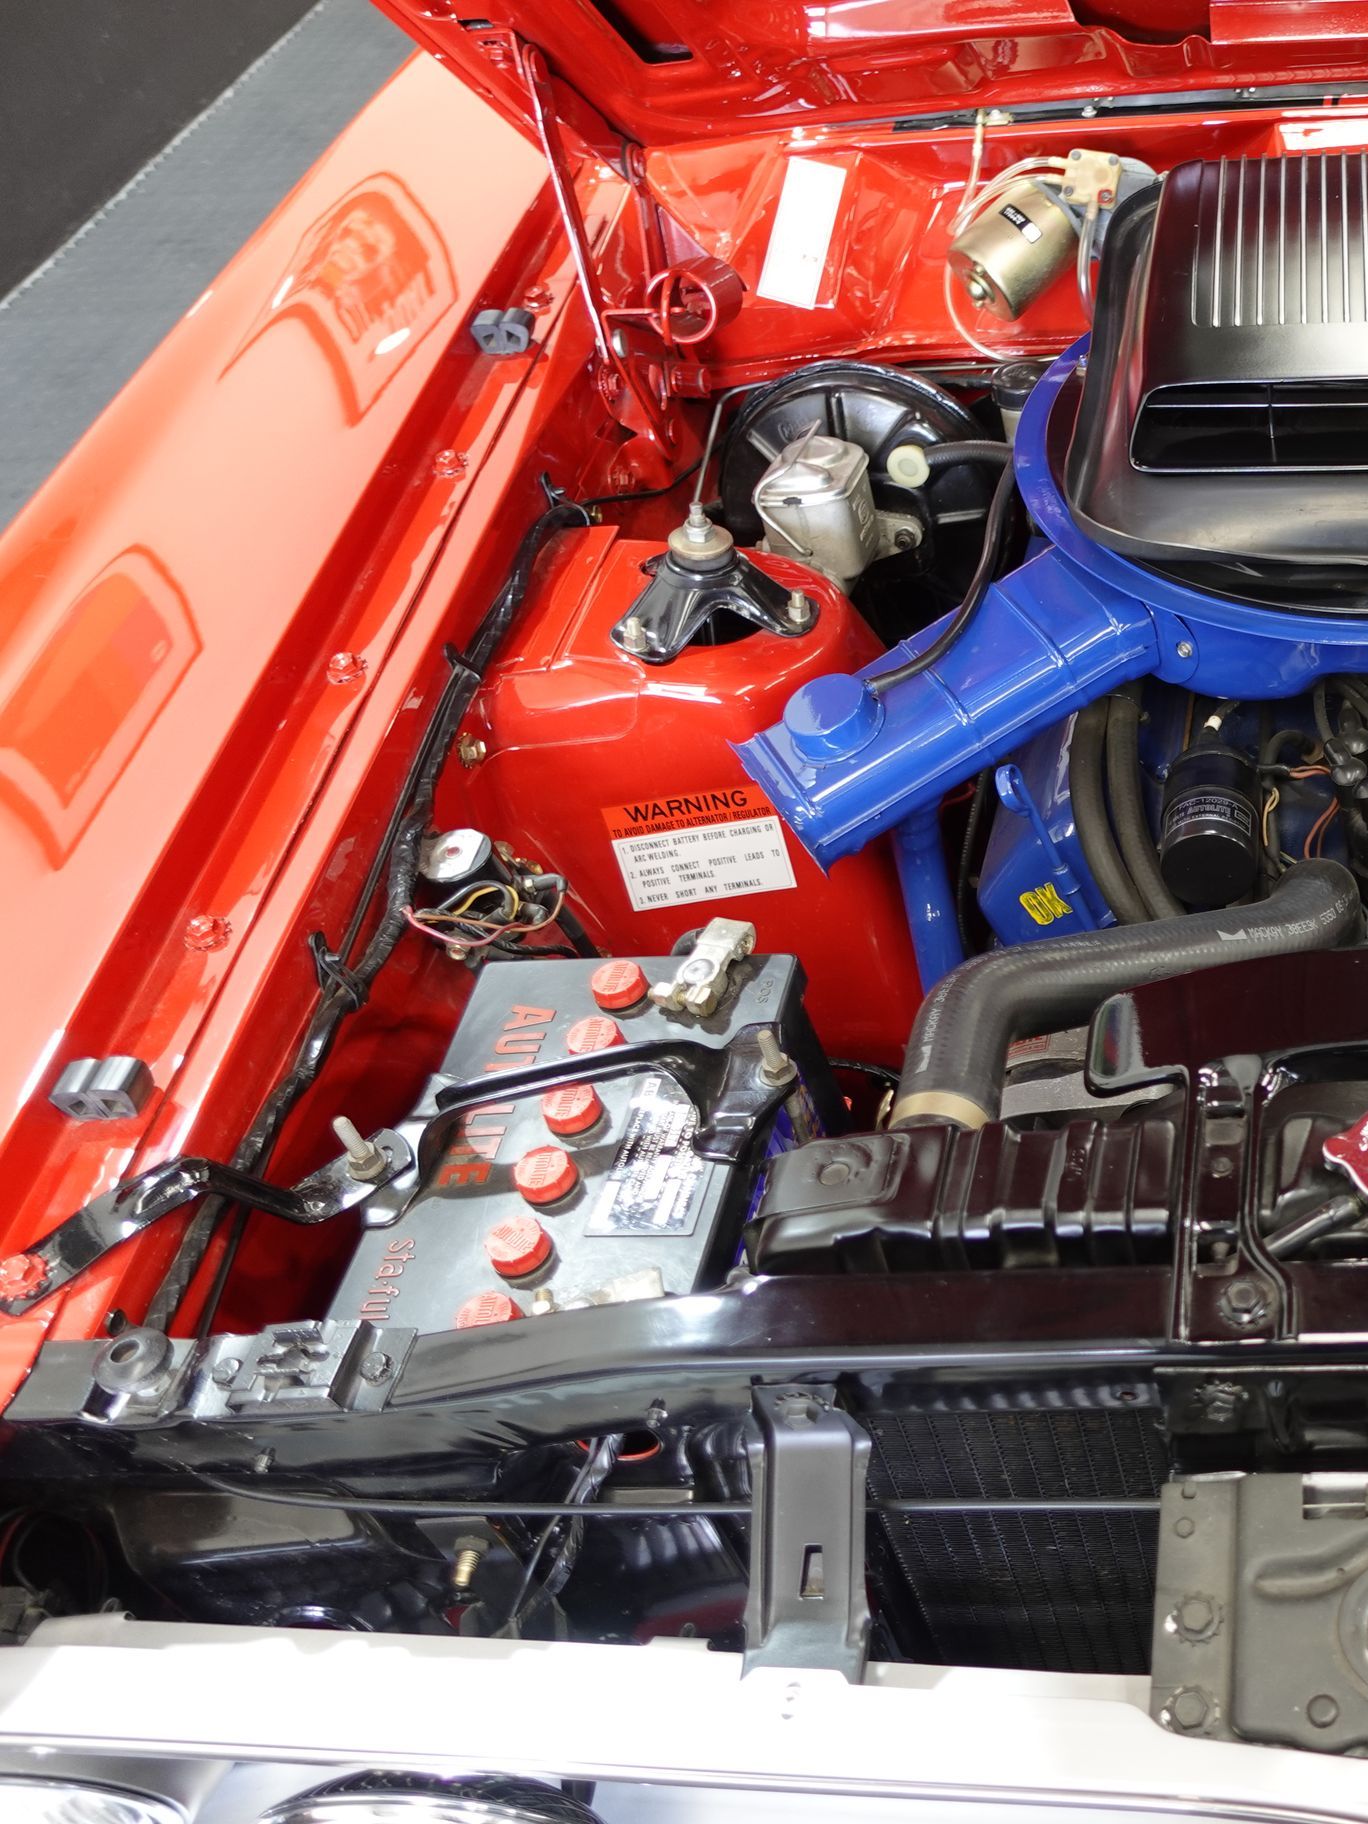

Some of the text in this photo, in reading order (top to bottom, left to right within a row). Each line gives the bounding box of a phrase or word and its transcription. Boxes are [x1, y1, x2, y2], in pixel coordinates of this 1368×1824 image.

[624, 790, 748, 823] WARNING
[1187, 804, 1231, 815] AUTOLITE
[613, 829, 623, 838] TO
[624, 825, 645, 837] AVOID
[646, 821, 675, 834] DAMAGE
[676, 819, 686, 829] TO
[686, 812, 728, 827] ALTERNATOR
[733, 807, 771, 820] REGULATOR
[629, 839, 670, 852] DISCONNECT
[673, 834, 700, 846] BATTERY
[703, 830, 726, 841] BEFORE
[729, 825, 762, 837] CHARGING
[765, 823, 774, 832] OR
[634, 854, 647, 864] ARC
[639, 867, 665, 878] ALWAYS
[671, 861, 700, 873] CONNECT
[708, 856, 737, 867] POSITIVE
[744, 852, 765, 862] LEADS
[771, 849, 780, 857] TO
[642, 878, 671, 889] POSITIVE
[647, 893, 669, 904] NEVER
[675, 887, 697, 899] SHORT
[705, 885, 718, 894] ANY
[1019, 881, 1073, 925] OK
[924, 1008, 942, 1043] MACKAY
[437, 1004, 557, 1185] AUTLITE
